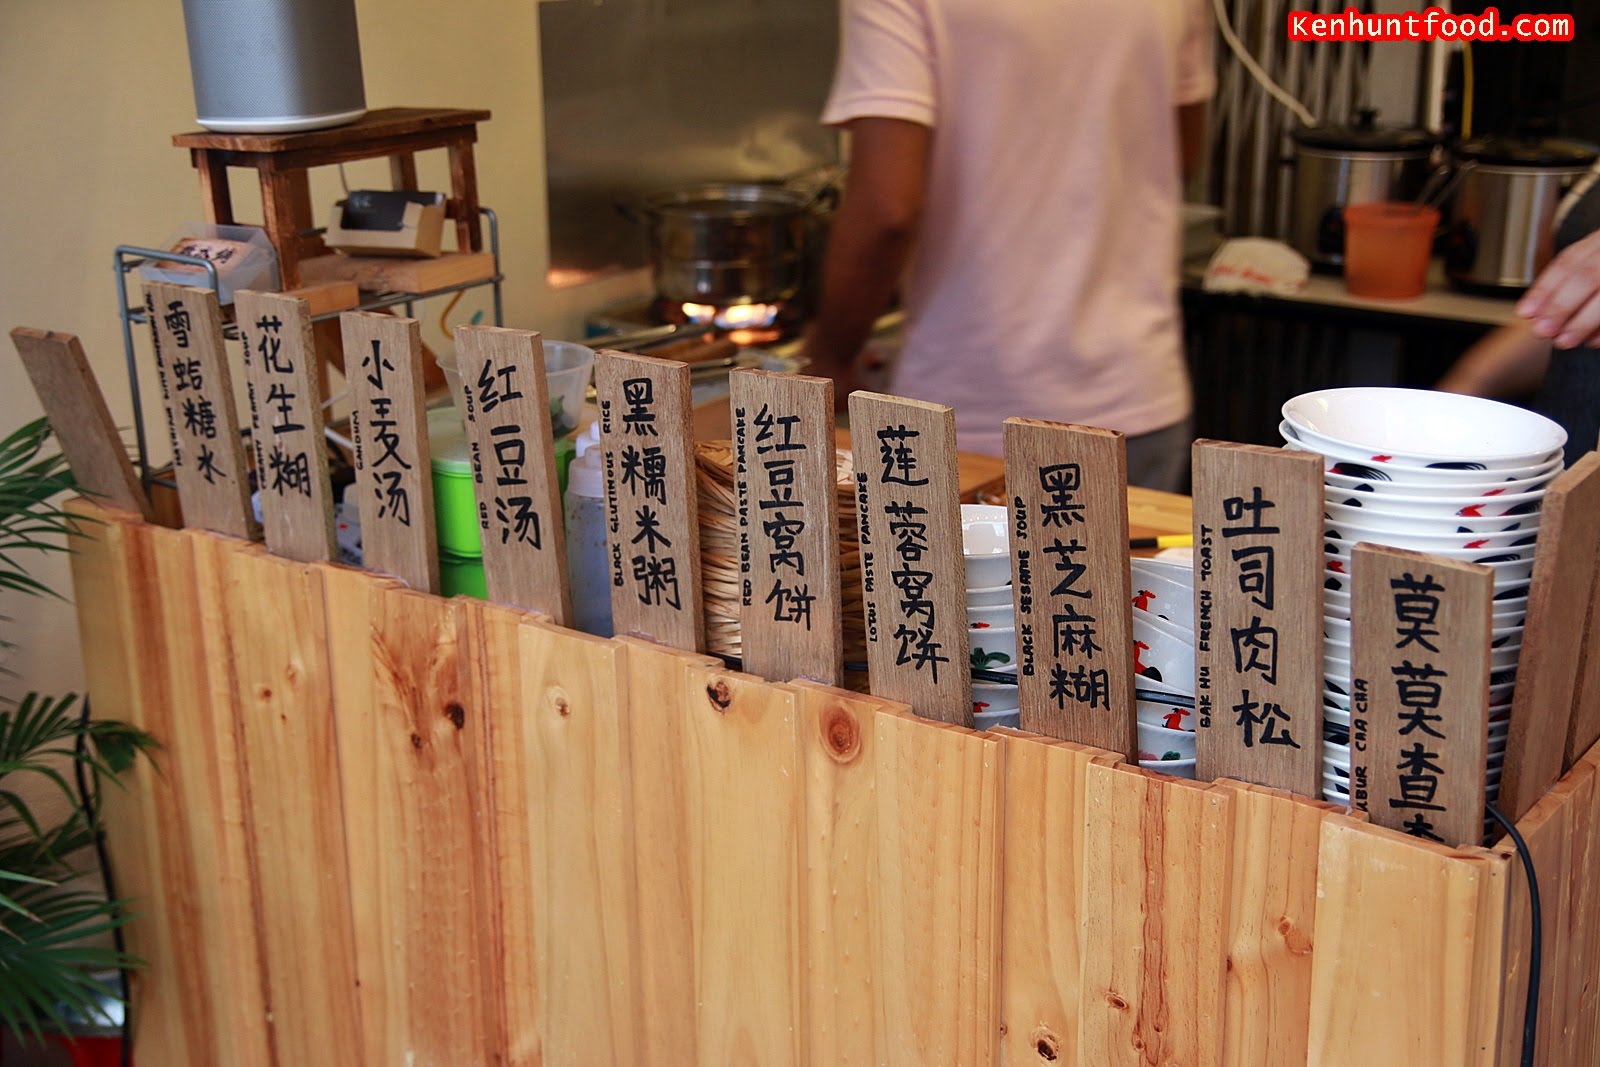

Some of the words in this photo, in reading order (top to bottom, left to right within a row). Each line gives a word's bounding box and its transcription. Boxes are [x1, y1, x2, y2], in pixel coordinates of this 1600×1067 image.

[164, 300, 227, 485] 雪蛤糖水
[256, 315, 312, 498] 花生糊
[464, 385, 476, 423] SOUP
[601, 399, 611, 435] RICE
[352, 410, 364, 471] GANDUM
[361, 339, 413, 527] 小麦汤
[477, 358, 543, 551] 红豆汤
[734, 406, 747, 474] PANCAKE
[471, 442, 484, 484] BEAN
[480, 501, 490, 530] RED
[605, 450, 619, 534] GLUTINOUS
[621, 377, 682, 611] 黑糯米粥
[738, 479, 751, 528] PASTE
[752, 402, 818, 632] 红豆窝饼
[858, 472, 872, 545] PANCAKE
[1014, 496, 1028, 540] SOUP
[613, 543, 624, 587] BLACK
[740, 530, 752, 574] BEAN
[864, 550, 875, 593] PASTE
[876, 424, 951, 685] 莲蓉窝饼
[1199, 523, 1214, 580] TOAST
[742, 578, 754, 607] RED
[1020, 550, 1033, 615] SESAME
[1038, 462, 1113, 713] 黑芝麻糊
[868, 600, 879, 643] LOTUS
[1198, 589, 1213, 653] FRENCH
[1221, 485, 1302, 751] 吐司肉松
[1022, 622, 1036, 677] BLACK
[1199, 665, 1211, 690] HU
[1354, 678, 1369, 715] CHA
[1199, 694, 1213, 729] BAK
[1354, 718, 1369, 753] CHA
[1354, 766, 1369, 812] UBUR
